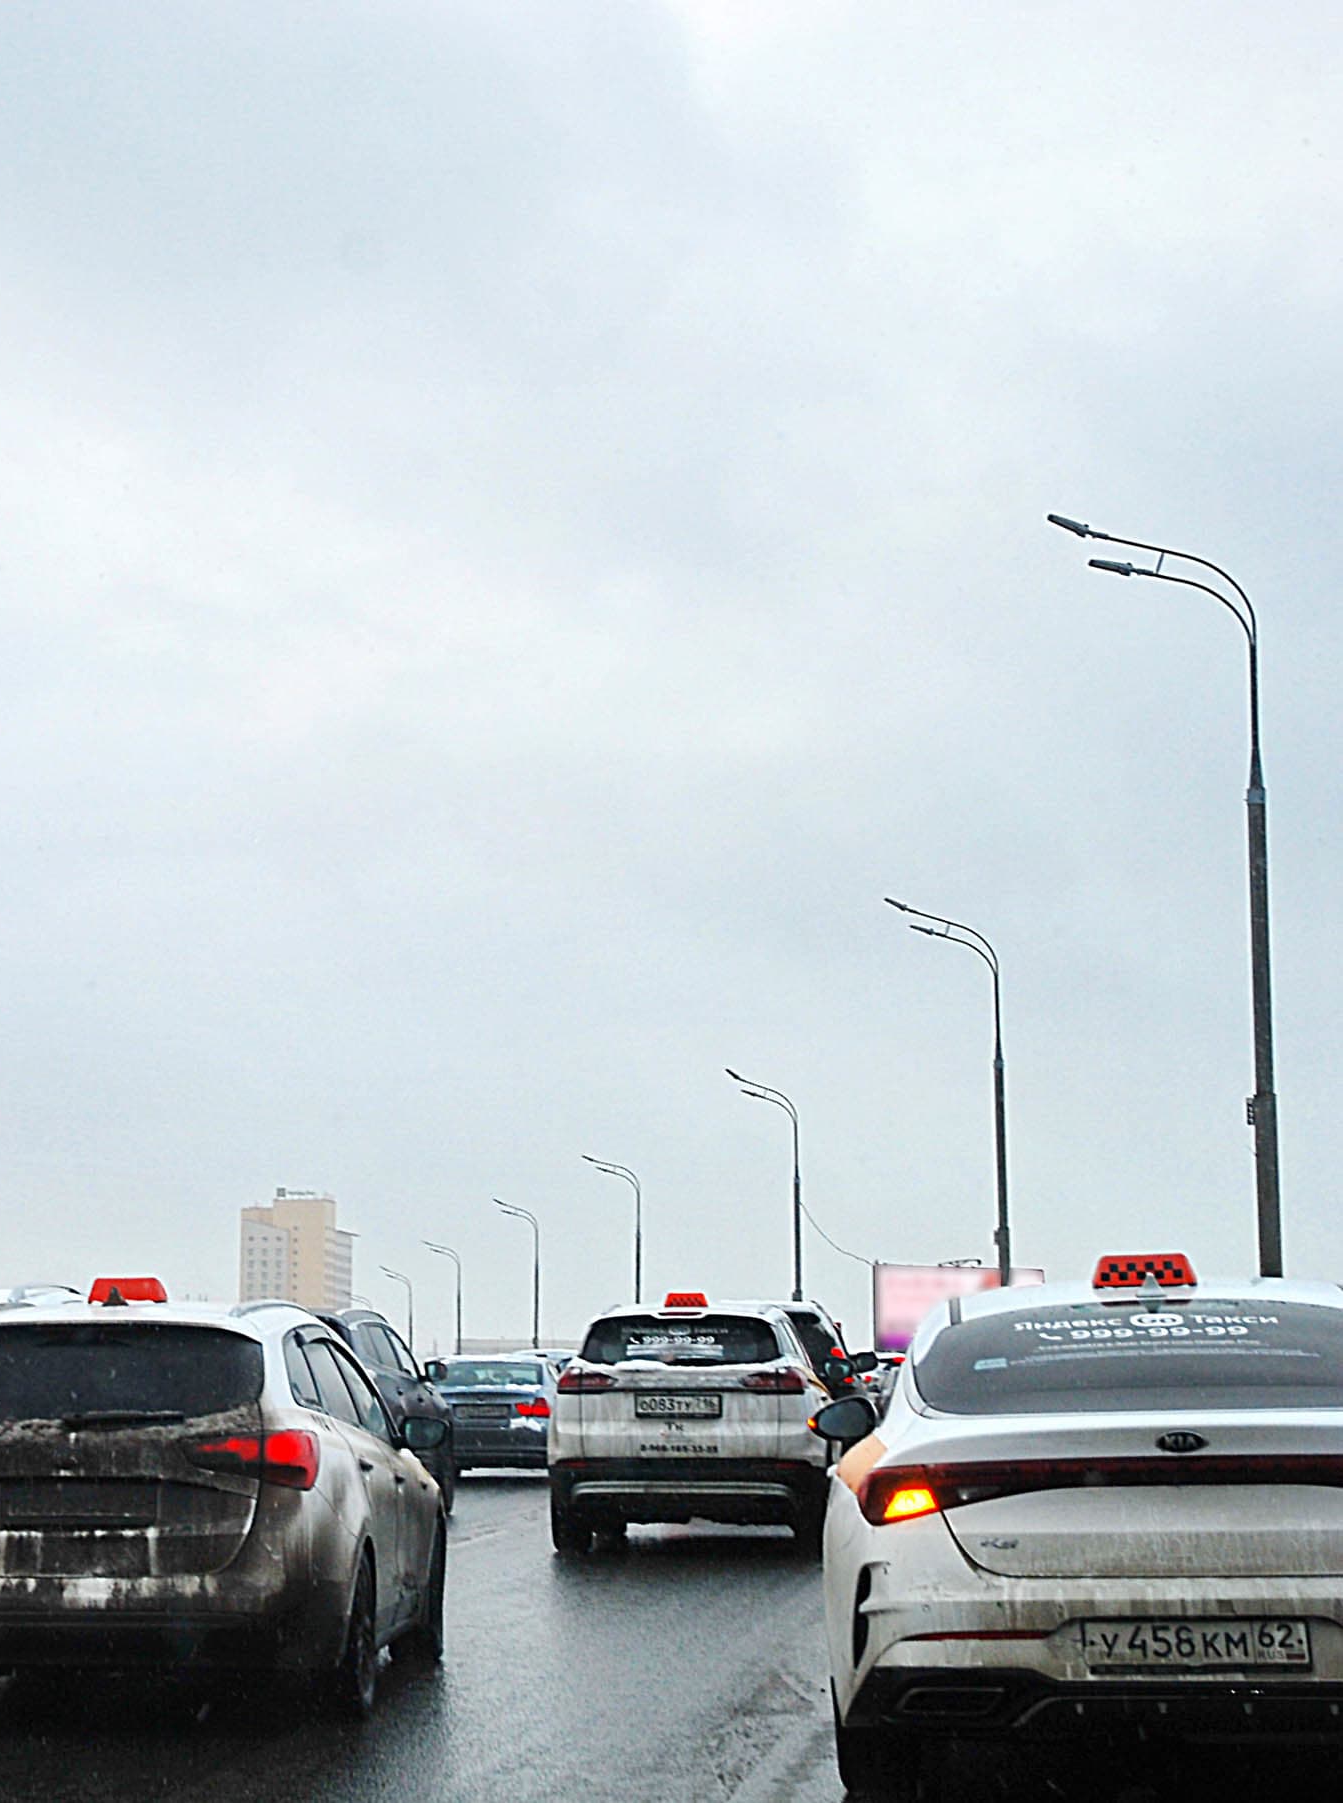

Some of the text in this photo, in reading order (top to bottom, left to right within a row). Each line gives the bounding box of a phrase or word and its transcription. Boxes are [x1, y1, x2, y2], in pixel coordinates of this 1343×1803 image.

[1014, 1318, 1122, 1331] Яндекс
[1188, 1314, 1280, 1325] Такси
[1070, 1326, 1249, 1340] 999-99-99
[1164, 1435, 1199, 1448] KIA
[1258, 1622, 1295, 1648] 62
